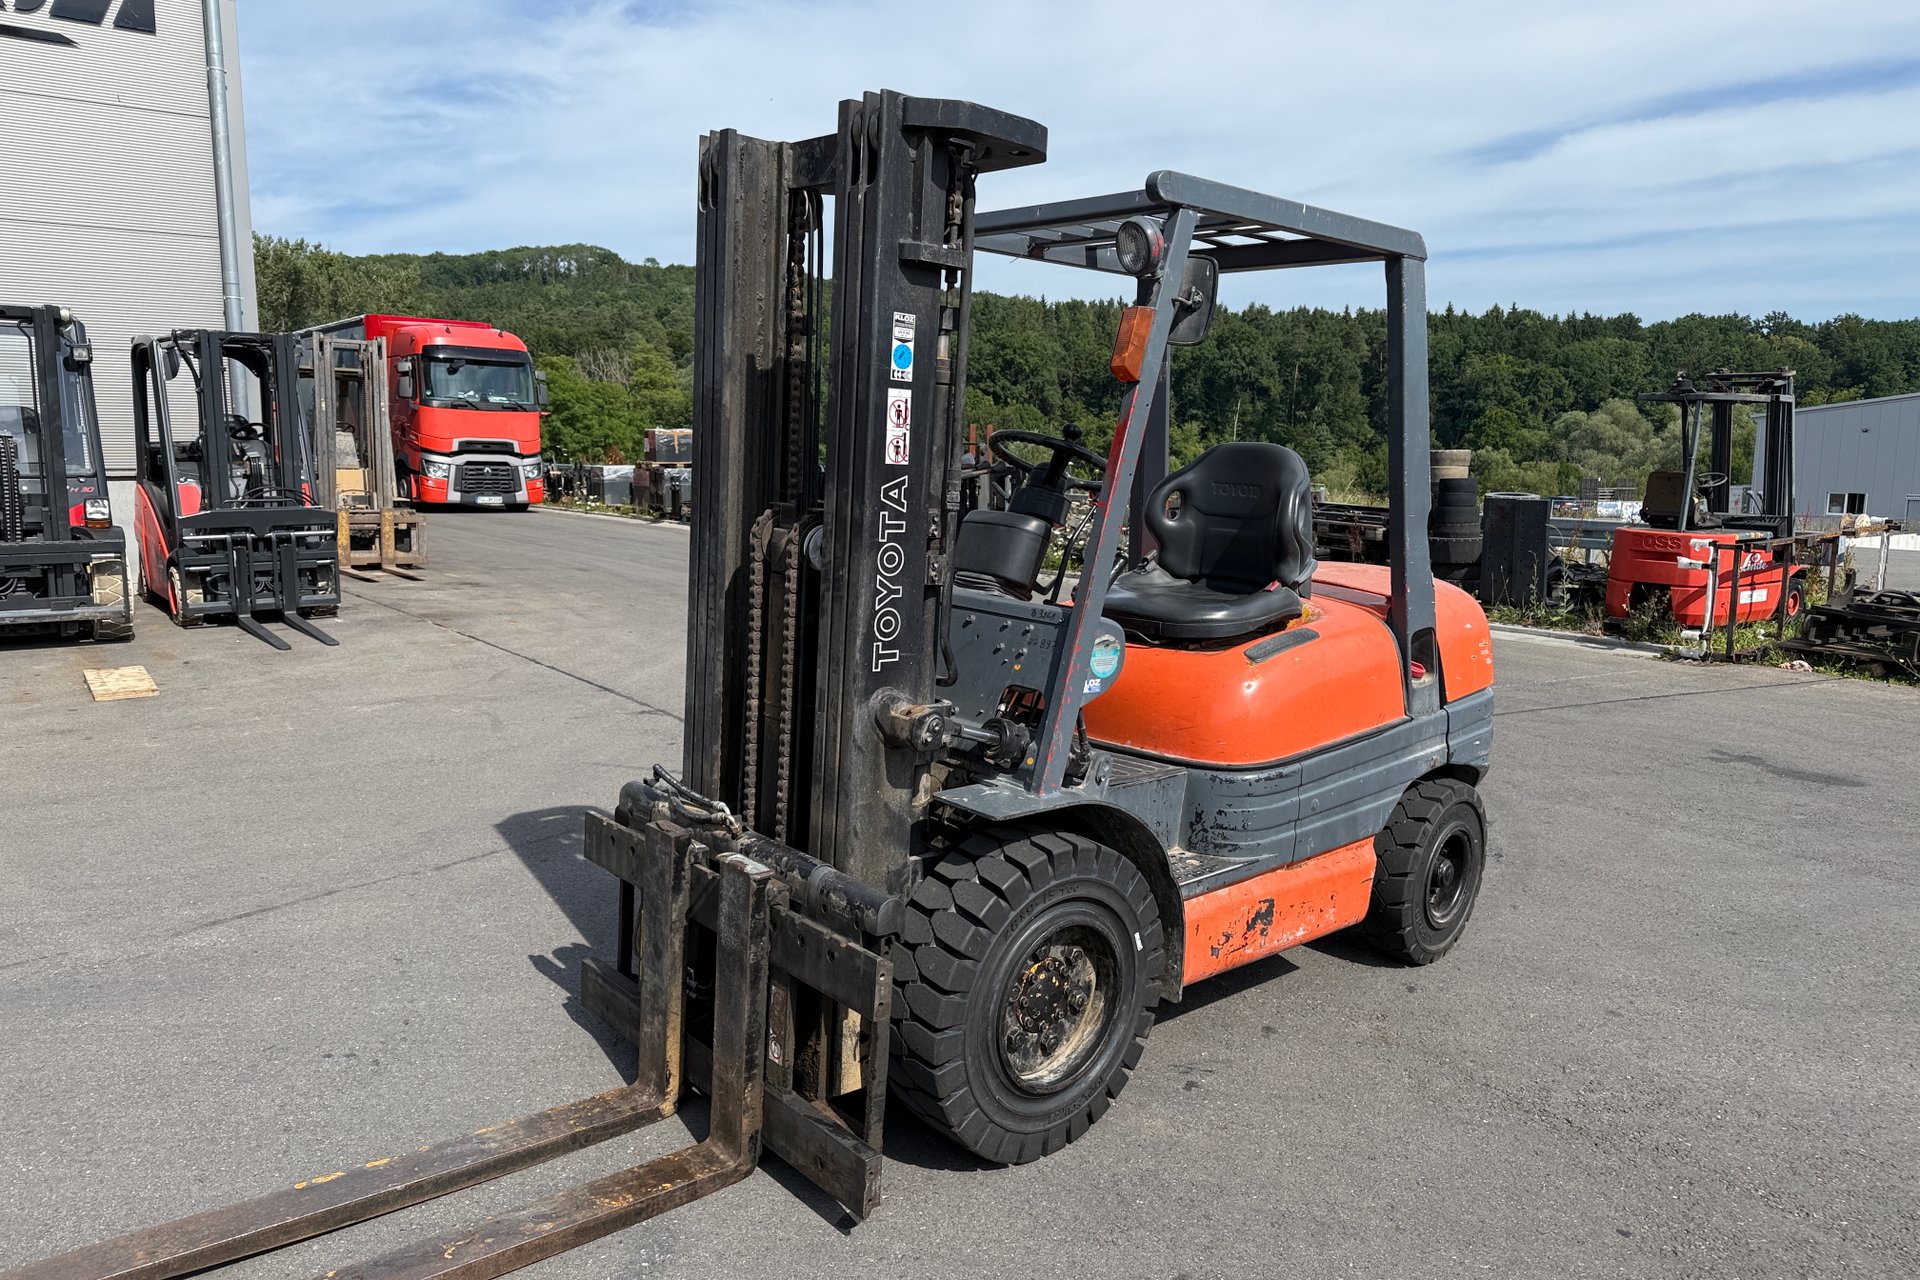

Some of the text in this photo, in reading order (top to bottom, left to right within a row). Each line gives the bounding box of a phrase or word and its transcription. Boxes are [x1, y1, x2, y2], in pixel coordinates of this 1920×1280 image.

[894, 313, 914, 322] KLOZ
[1211, 480, 1263, 498] TOYOT
[1739, 552, 1769, 573] Linde
[872, 474, 909, 673] TOYOTA
